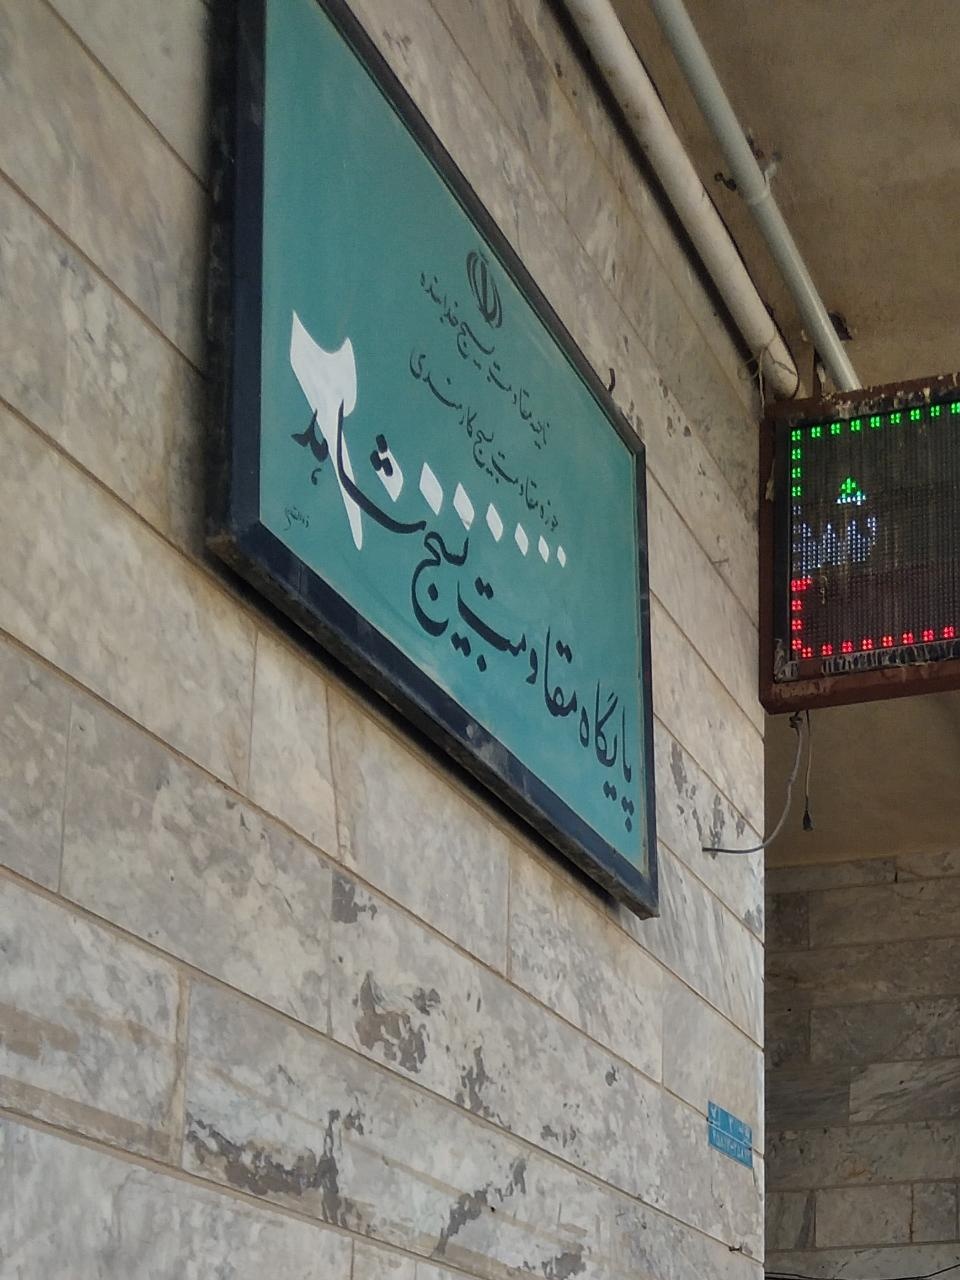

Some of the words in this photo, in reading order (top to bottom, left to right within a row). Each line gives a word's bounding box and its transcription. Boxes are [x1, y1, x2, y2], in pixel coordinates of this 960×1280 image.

[409, 348, 477, 438] کارمندی
[457, 321, 496, 383] بسیج
[486, 362, 533, 421] مقاومت
[291, 399, 426, 535] شاهد
[473, 430, 500, 485] بسیج
[491, 451, 538, 509] مقاومت
[411, 531, 487, 673] بسیج
[457, 576, 578, 717] مقاومت
[579, 679, 635, 833] پایگاه
